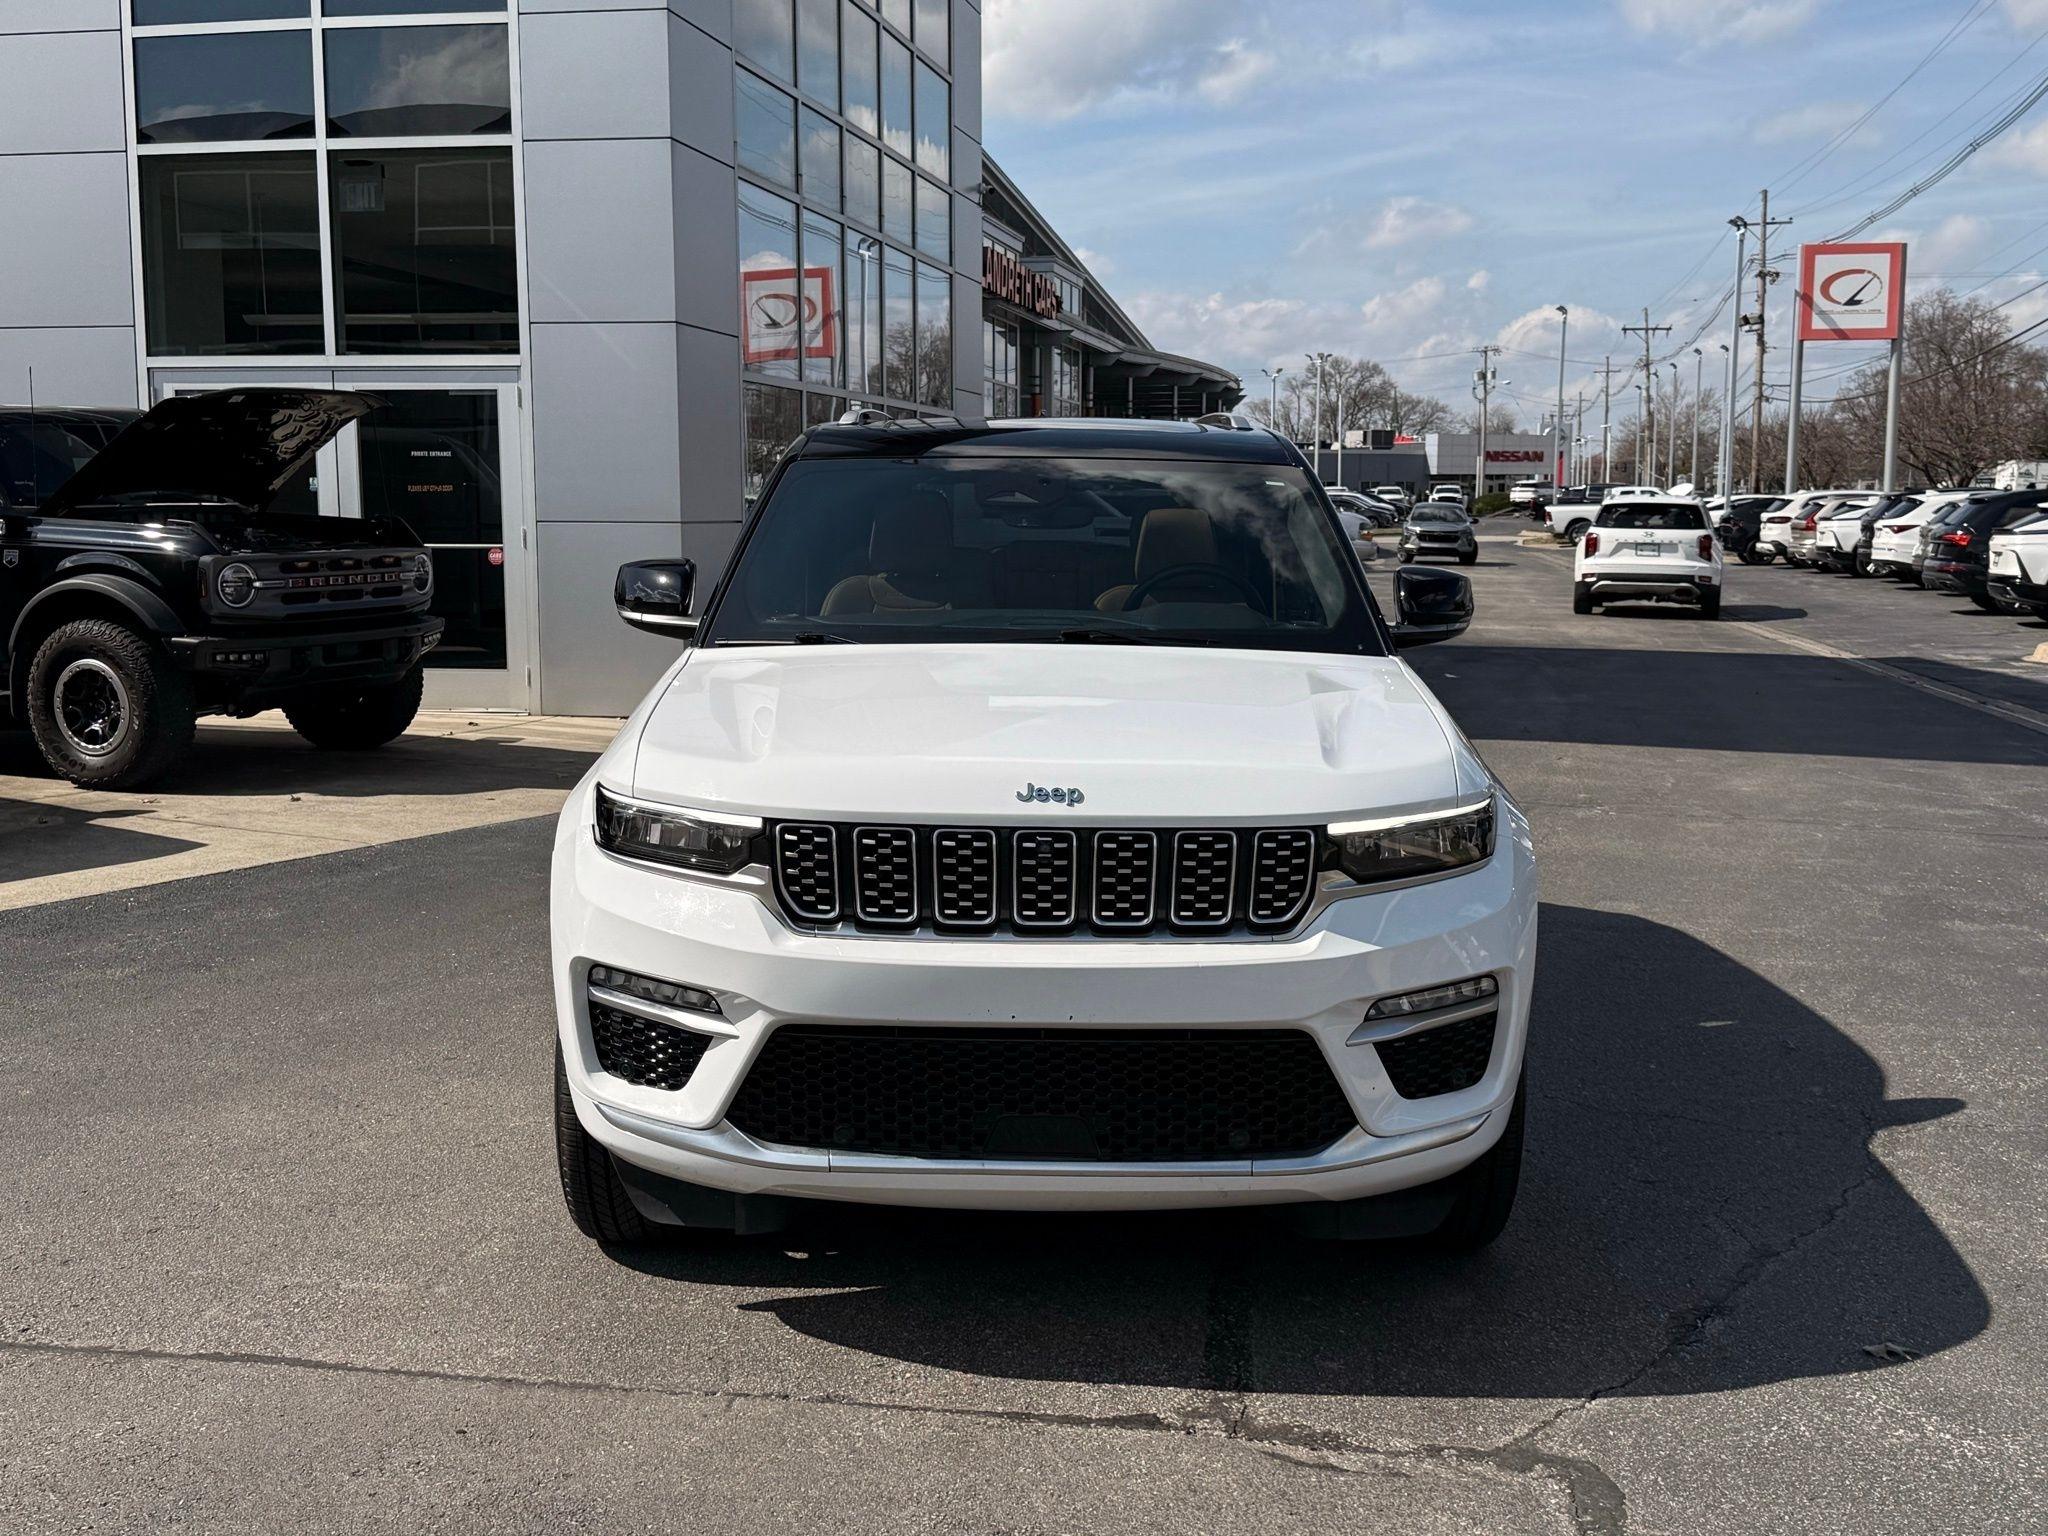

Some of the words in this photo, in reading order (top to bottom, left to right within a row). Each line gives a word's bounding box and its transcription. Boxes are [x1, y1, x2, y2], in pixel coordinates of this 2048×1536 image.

[1035, 272, 1057, 319] CARS
[1485, 450, 1544, 462] NISSAN
[289, 571, 399, 588] BRONCO
[1015, 782, 1085, 808] Jeep
